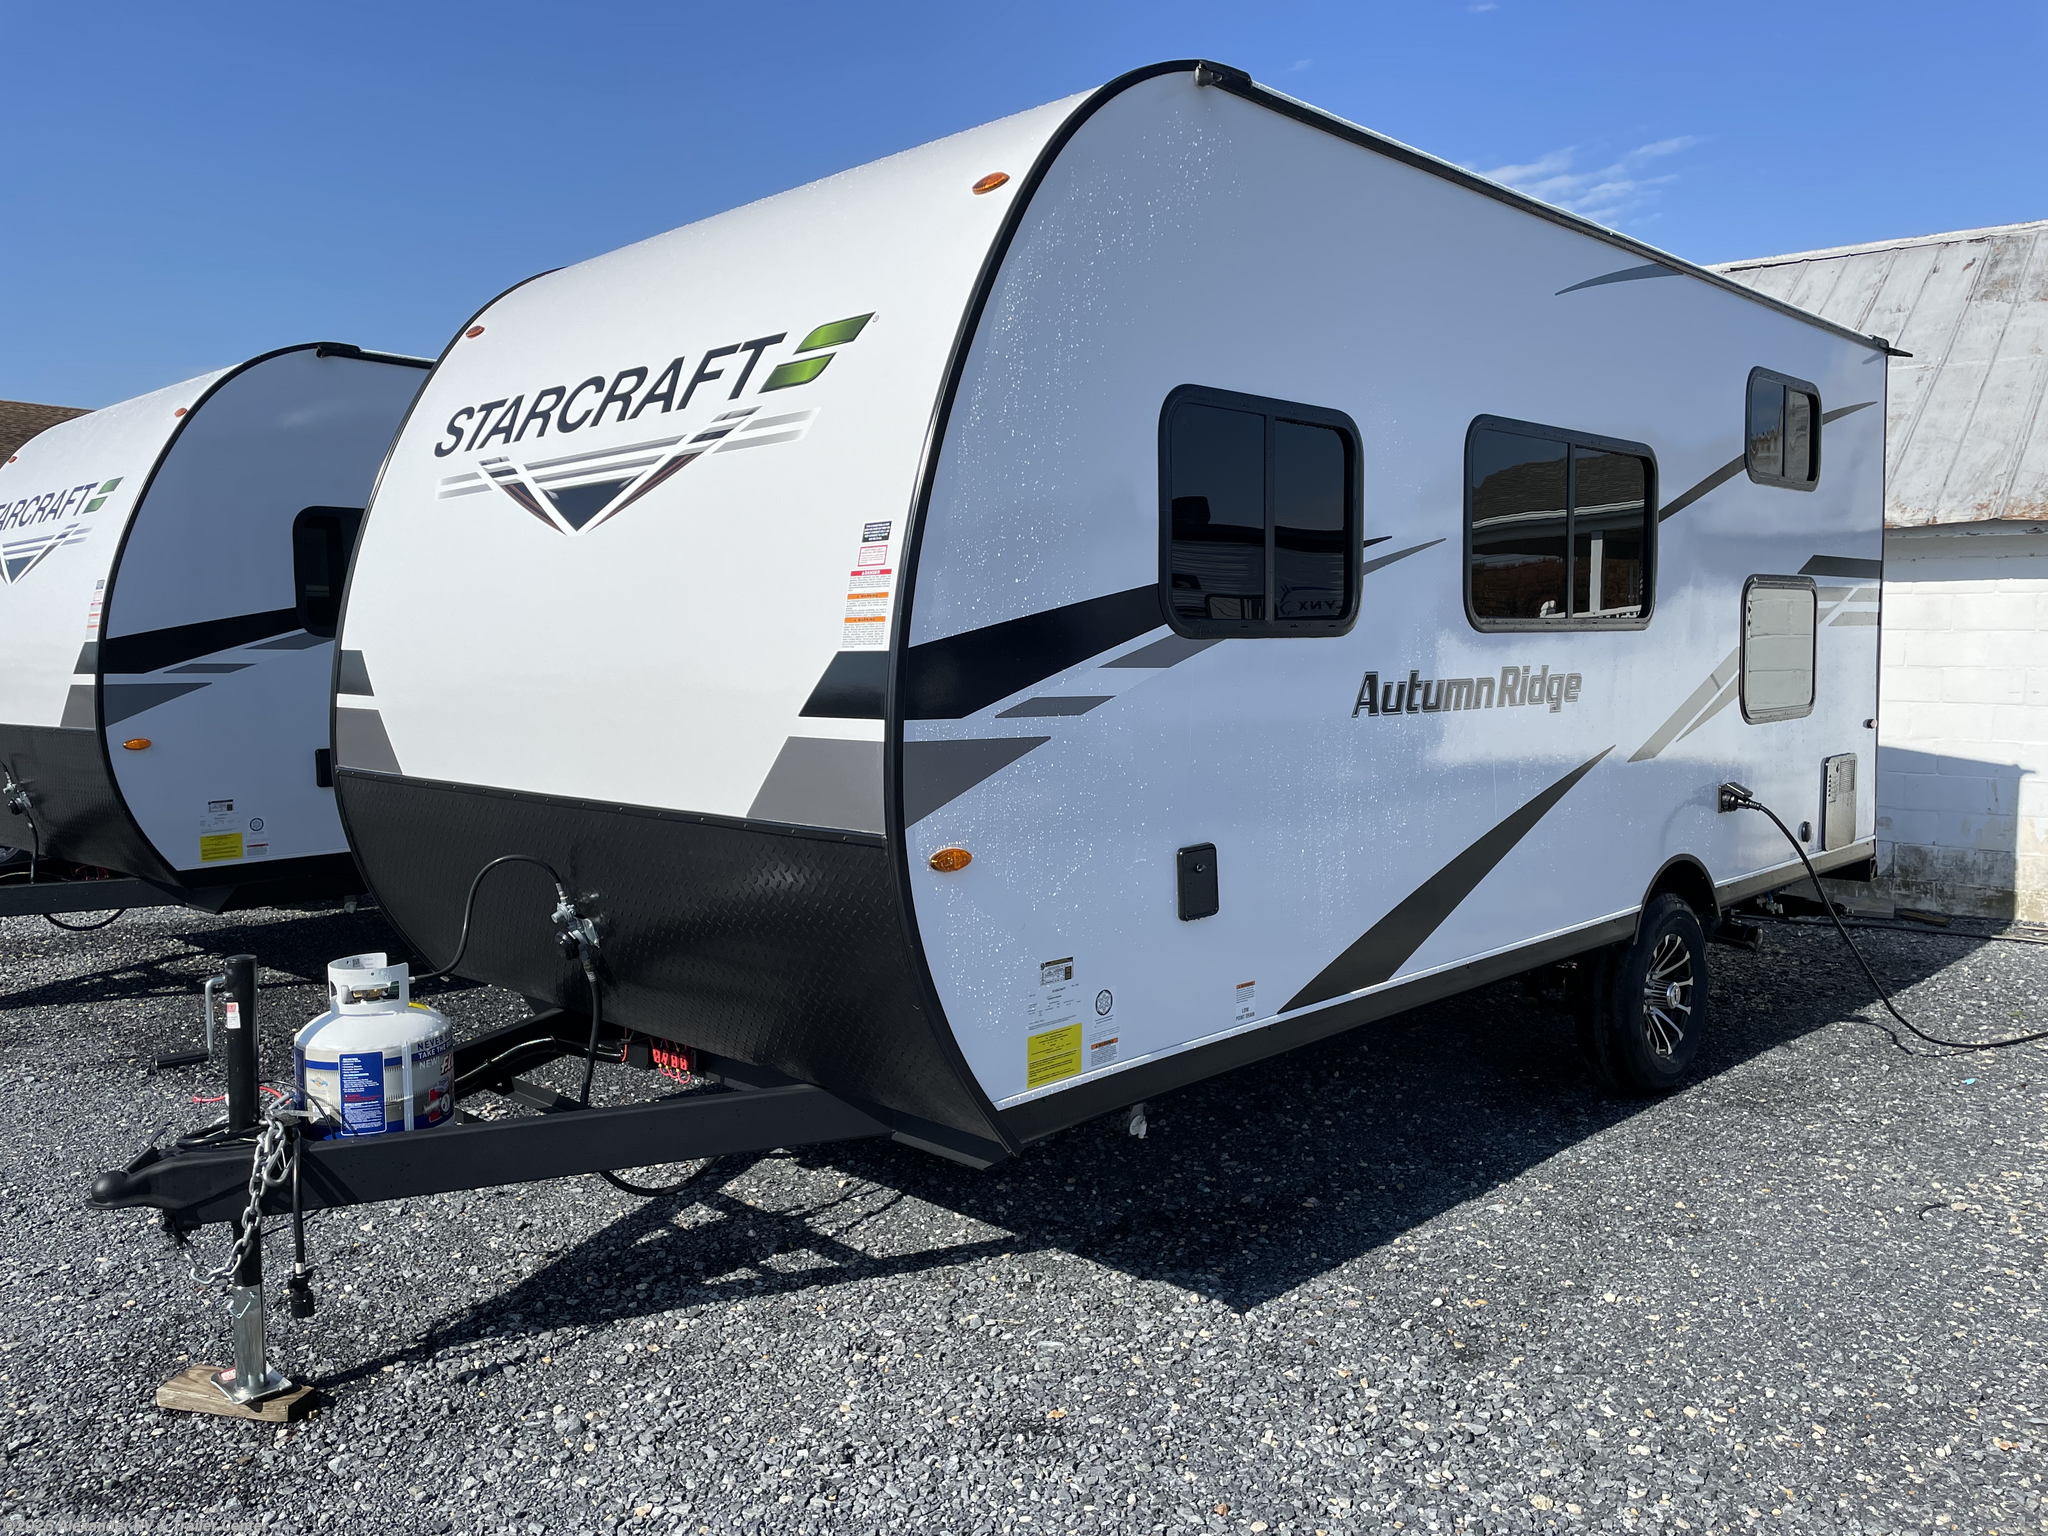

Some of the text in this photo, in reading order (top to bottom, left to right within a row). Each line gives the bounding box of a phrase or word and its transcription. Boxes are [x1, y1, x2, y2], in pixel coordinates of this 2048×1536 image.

[434, 331, 788, 458] STARCRAFT
[417, 1034, 444, 1051] NEVER
[418, 1048, 436, 1059] TAKE
[419, 1055, 440, 1070] NEW!
